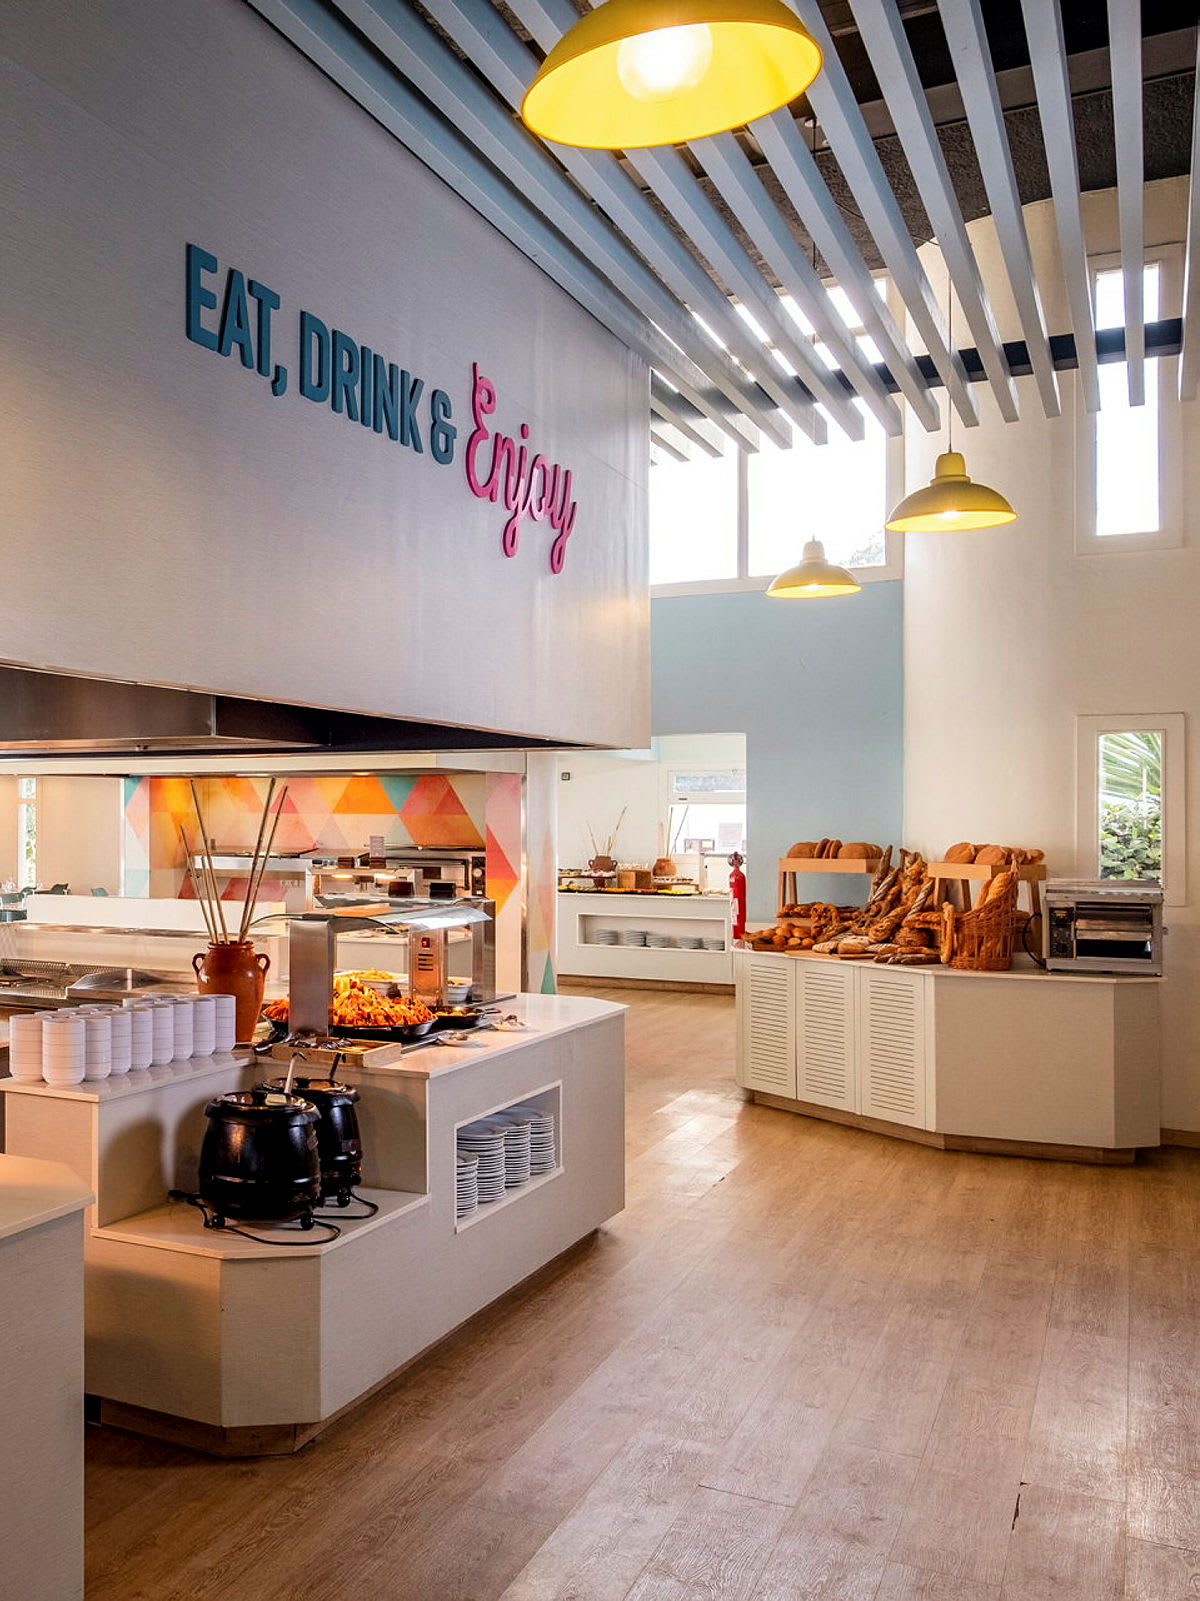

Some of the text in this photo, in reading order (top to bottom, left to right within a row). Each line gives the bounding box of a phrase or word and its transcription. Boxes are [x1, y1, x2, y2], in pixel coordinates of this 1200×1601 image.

[186, 242, 577, 574] EAT, DRINK & Enjoy
